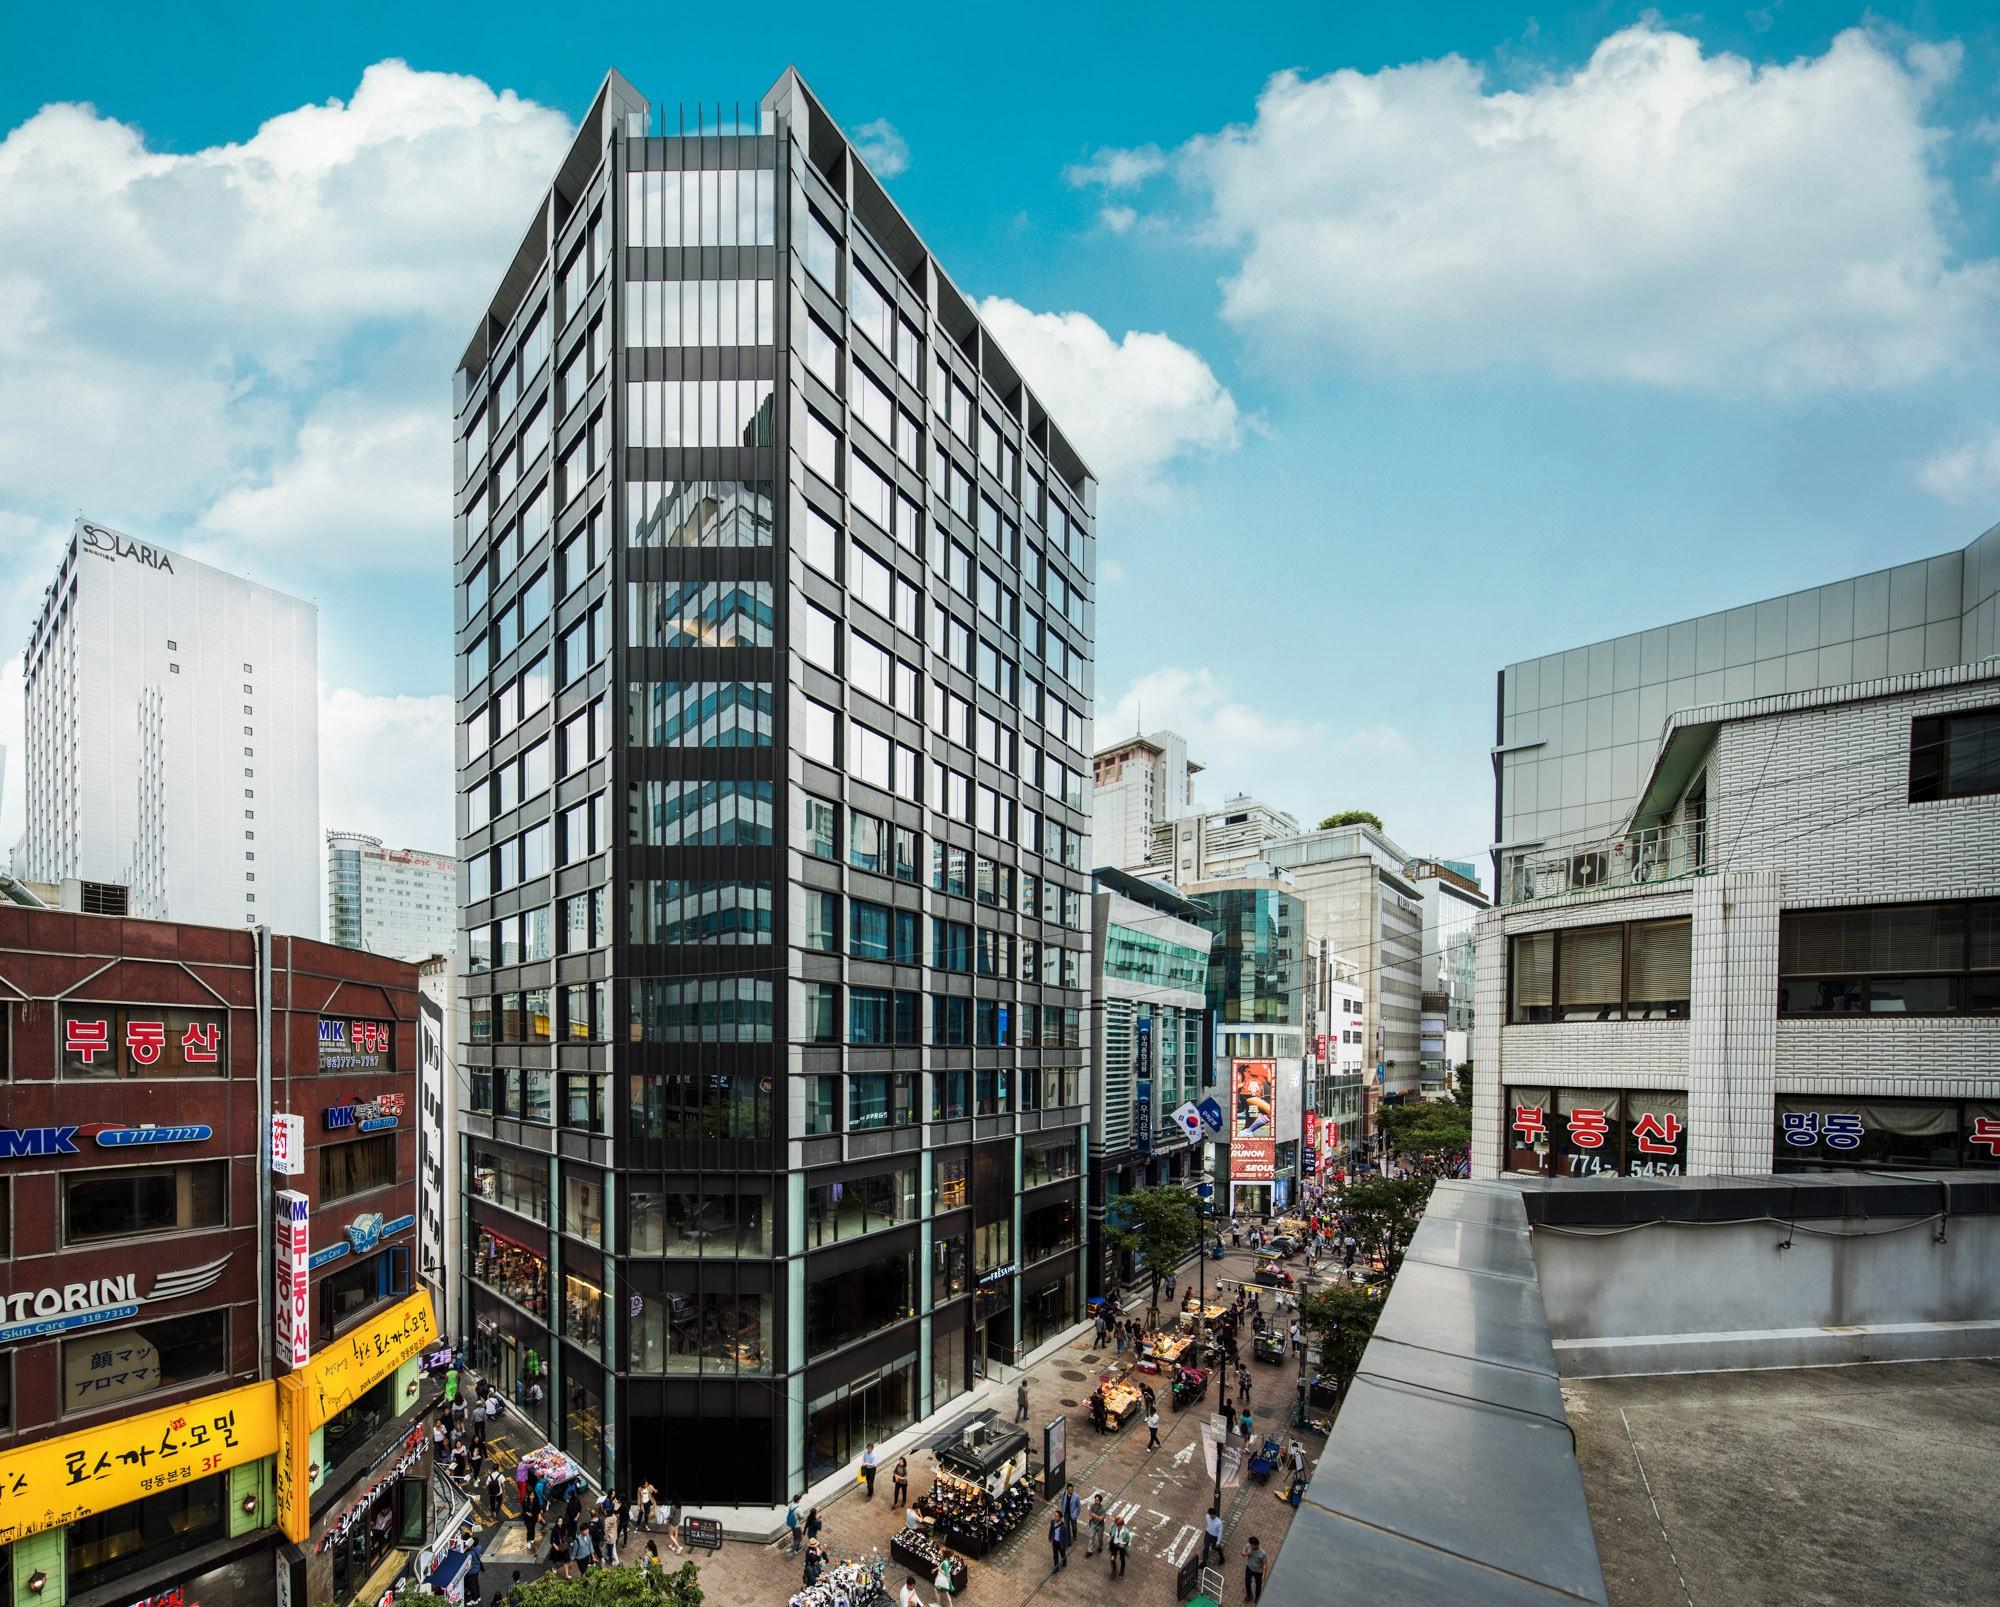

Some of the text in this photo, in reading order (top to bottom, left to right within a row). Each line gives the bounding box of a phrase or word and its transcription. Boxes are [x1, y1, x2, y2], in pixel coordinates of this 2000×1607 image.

[83, 525, 174, 575] SOLARIA
[66, 1019, 221, 1065] 부동산
[320, 1020, 389, 1053] MK 부동산
[328, 1105, 357, 1129] MK
[379, 1093, 405, 1116] 명동
[1139, 1104, 1148, 1141] 우리은행
[0, 1126, 80, 1158] MK
[113, 1127, 200, 1143] T 777-7727
[1513, 1105, 1682, 1155] 부동산
[1782, 1112, 1865, 1150] 명동
[1245, 1164, 1276, 1172] SEOUL
[1631, 1160, 1681, 1177] 5454
[276, 1196, 292, 1219] MK
[293, 1200, 307, 1222] MK
[315, 1248, 341, 1265] Skin Care
[276, 1219, 292, 1343] 부동산
[293, 1225, 308, 1364] 부동산
[1, 1307, 132, 1341] Skin Care 318-7314
[418, 1336, 426, 1349] 3F
[140, 1452, 224, 1491] 명동본점 3F
